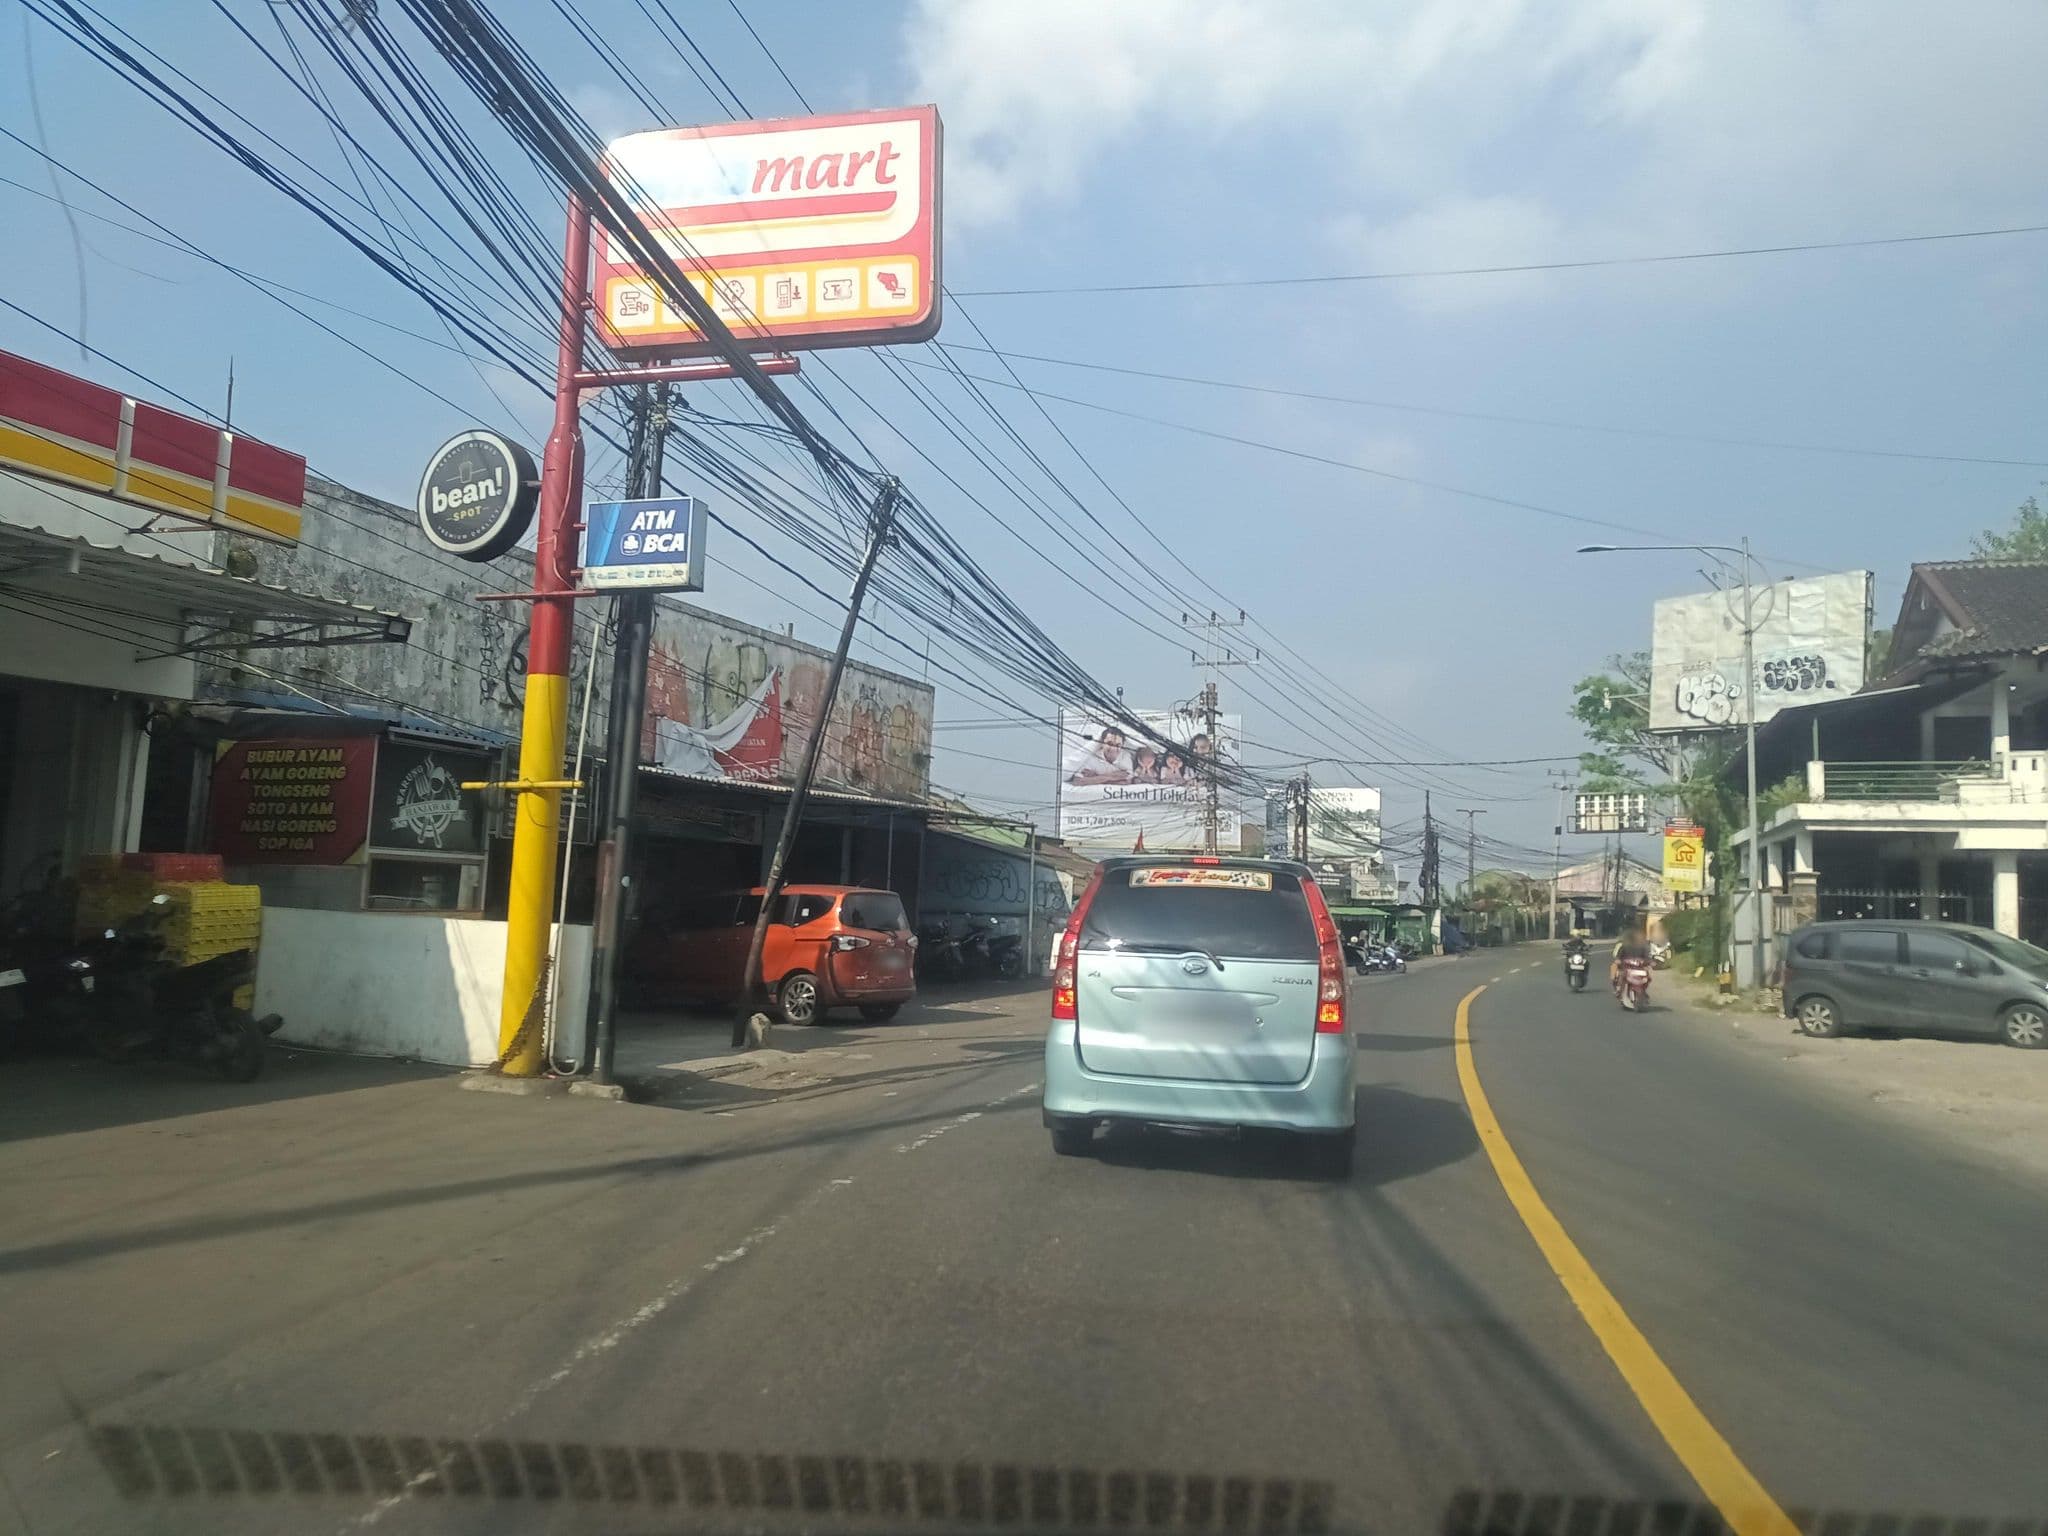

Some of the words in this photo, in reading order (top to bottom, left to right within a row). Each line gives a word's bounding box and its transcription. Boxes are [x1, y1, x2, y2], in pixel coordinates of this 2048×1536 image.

[432, 466, 503, 514] bean!
[453, 505, 482, 522] SPOT
[630, 509, 676, 531] ATM
[642, 533, 685, 553] BCA
[247, 751, 296, 763] BUBUR
[296, 748, 343, 763] AYAM
[240, 767, 284, 780] AYAM
[286, 766, 347, 779] GORENG
[254, 784, 331, 798] TONGSENG
[1103, 786, 1149, 801] School
[247, 802, 286, 815] SOTO
[288, 802, 334, 815] AYAM
[240, 820, 275, 833] NASI
[277, 819, 337, 833] GORENG
[258, 837, 289, 850] SOP
[288, 837, 314, 850] IGA
